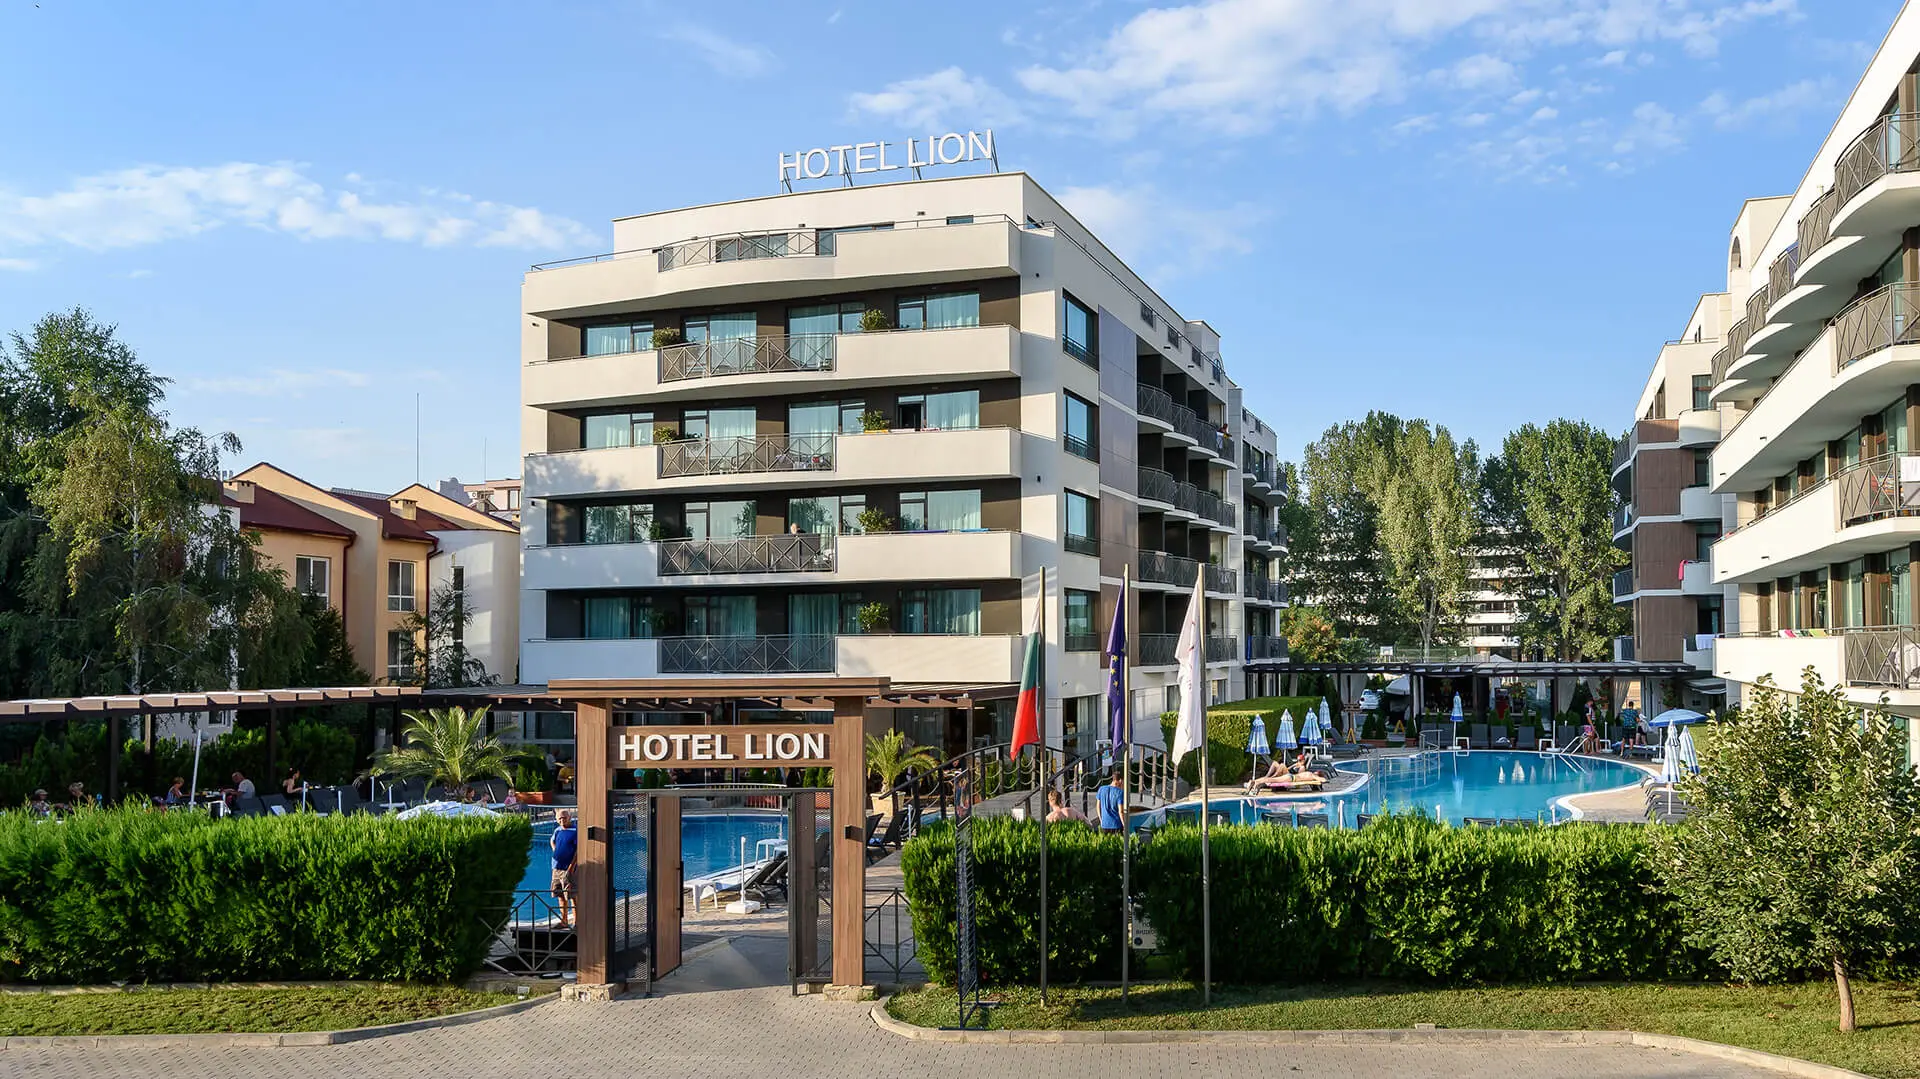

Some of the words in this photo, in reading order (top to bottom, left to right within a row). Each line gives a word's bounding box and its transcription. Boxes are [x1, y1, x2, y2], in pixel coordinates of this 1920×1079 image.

[779, 140, 898, 182] HOTEL
[908, 128, 992, 167] LION
[619, 733, 734, 761] HOTEL
[744, 732, 825, 760] LION
